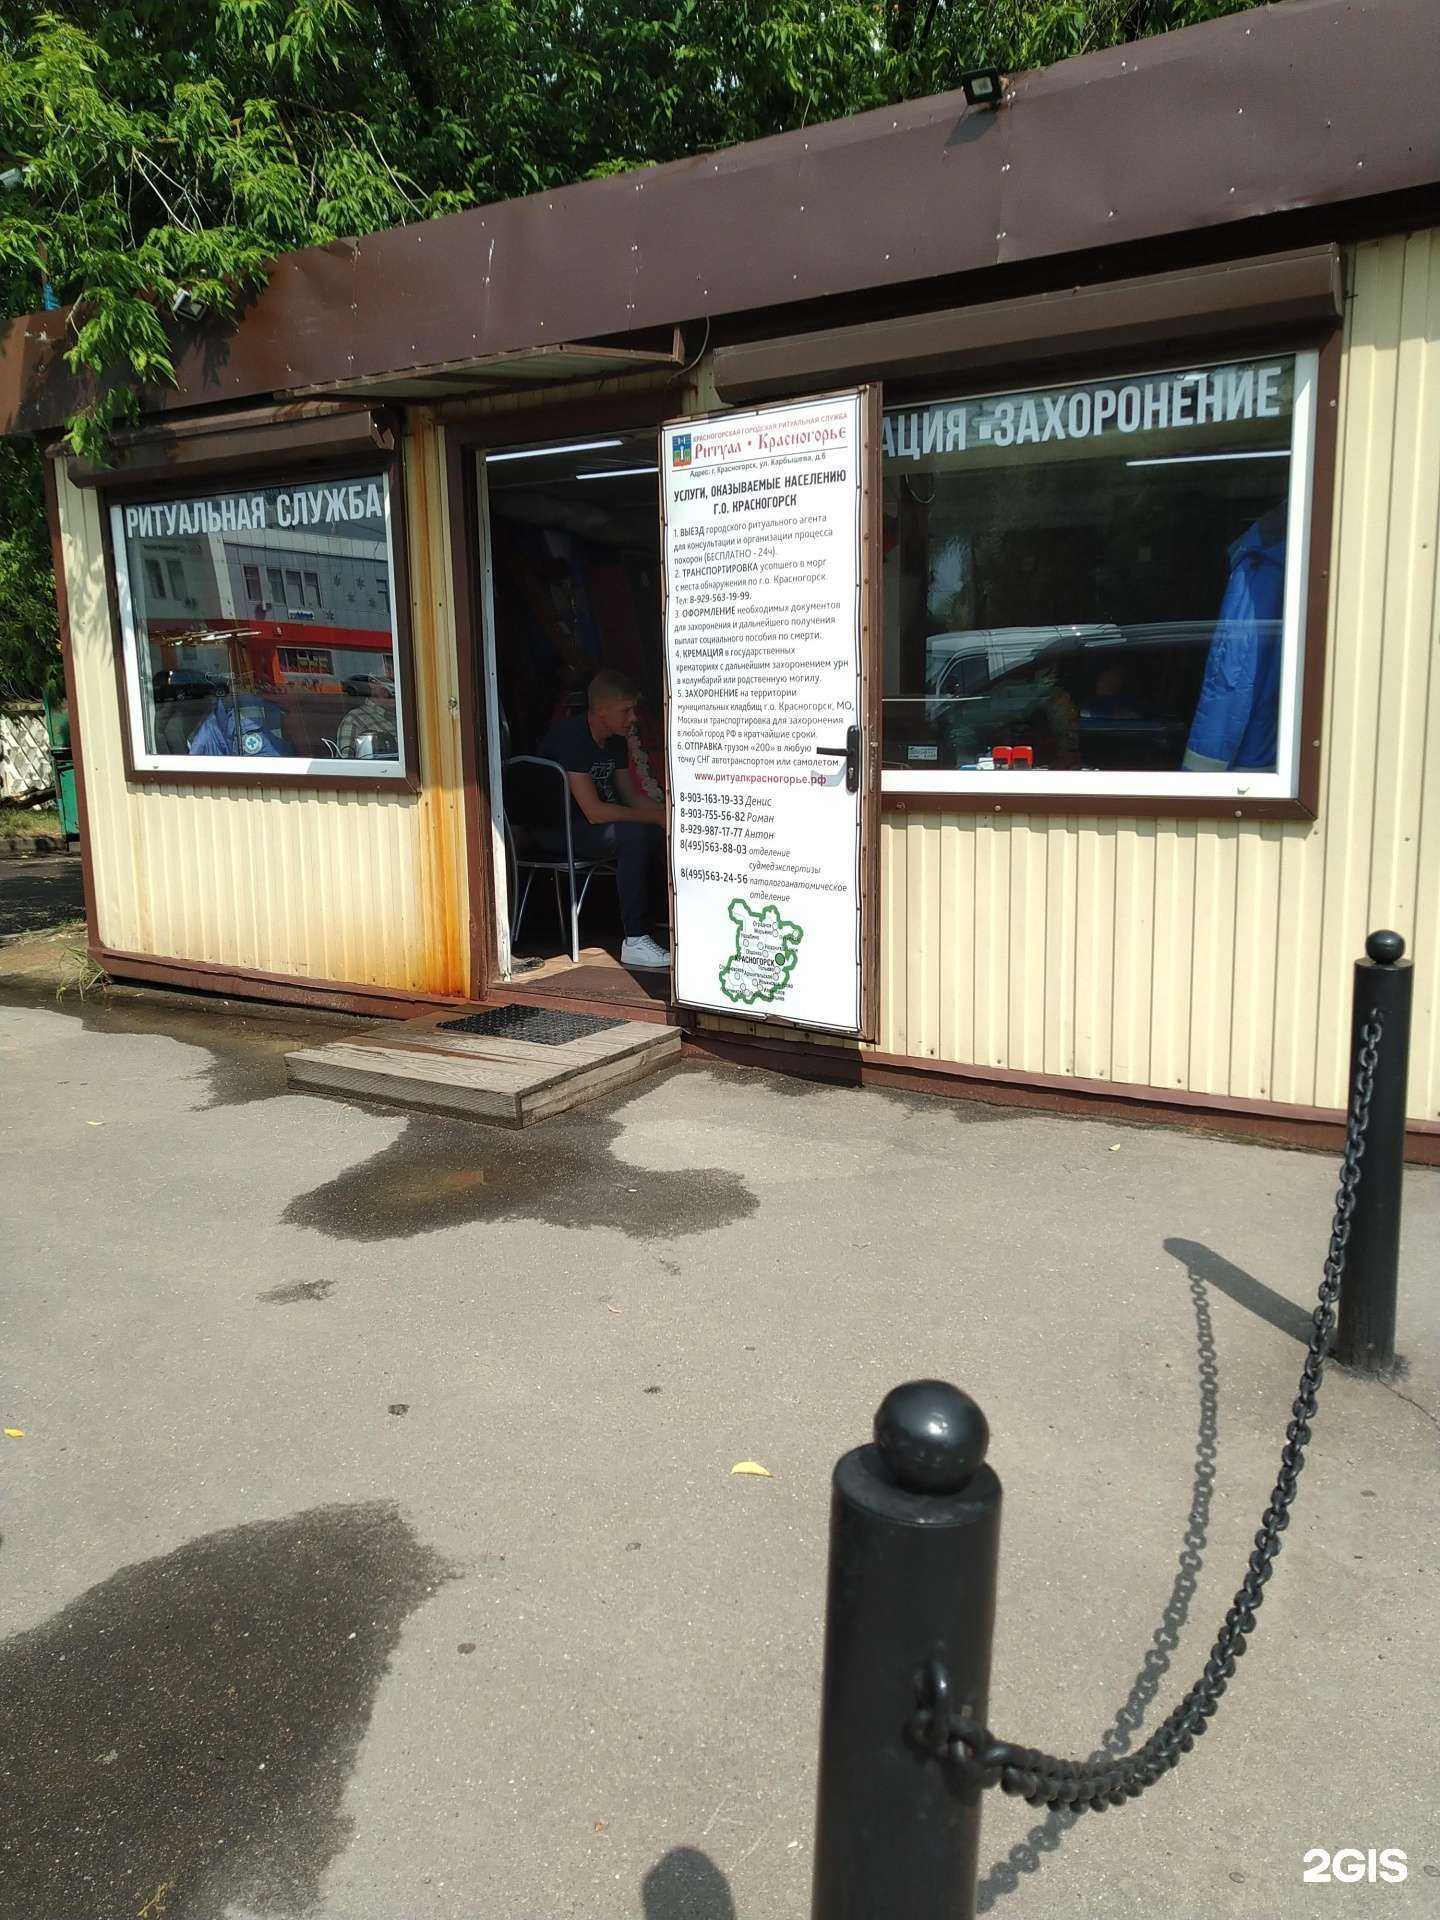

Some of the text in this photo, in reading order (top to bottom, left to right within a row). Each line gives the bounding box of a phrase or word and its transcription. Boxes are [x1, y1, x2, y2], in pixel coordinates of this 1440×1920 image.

[994, 367, 1282, 447] ЗАХОРОНЕНИЕ
[693, 412, 848, 442] КРАСНОГОРСКАЯ ГОРОДСКАЯ РИТУАЛЬНАЯ СЛУЖБА
[695, 427, 846, 460] Ритуал Красногорье
[674, 469, 847, 502] УСЛУГИ, ОКАЗЫВАЕМЫЕ НАСЕЛЕНИЮ
[126, 484, 382, 538] РИТУАЛЬНАЯ СЛУЖБА
[713, 494, 797, 515] Г.О. КРАСНОГОРСК
[680, 526, 704, 537] ВЫЕЗД
[706, 522, 746, 535] городского
[748, 518, 798, 532] ритуального
[799, 515, 827, 524] агента
[674, 543, 685, 553] для
[687, 538, 735, 551] консультации
[743, 533, 793, 545] организации
[795, 529, 833, 541] процесса
[674, 556, 703, 565] похорон
[704, 549, 752, 563] (БЕСПЛАТНО
[683, 562, 758, 578] ТРАНСПОРТИРОВКА
[760, 561, 798, 573] усопшего
[799, 560, 805, 568] в
[807, 559, 827, 568] морг
[680, 583, 699, 591] места
[700, 579, 746, 591] обнаружения
[682, 606, 735, 618] ОФОРМЛЕНИЕ
[737, 604, 789, 615] необходимых
[791, 602, 840, 613] документов
[674, 624, 686, 633] для
[688, 622, 731, 632] захоронения
[739, 618, 789, 629] дальнейшего
[791, 617, 836, 628] получения
[674, 637, 698, 645] выплат
[699, 635, 743, 645] социального
[745, 632, 776, 642] пособия
[683, 648, 723, 658] КРЕМАЦИЯ
[724, 649, 730, 657] в
[730, 647, 796, 659] государственных
[676, 663, 719, 674] крематориях
[725, 660, 770, 671] дальнейшим
[772, 660, 831, 671] захоронением
[832, 659, 849, 670] урн
[681, 675, 722, 686] колумбарий
[723, 676, 736, 684] или
[737, 676, 788, 686] родственную
[684, 688, 739, 698] ЗАХОРОНЕНИЕ
[750, 689, 797, 700] территории
[677, 703, 729, 713] муниципальных
[730, 701, 763, 712] кладбищ
[763, 703, 777, 711] г.о.
[836, 700, 855, 711] МО,
[677, 716, 703, 724] Москвы
[709, 717, 771, 727] транспортировка
[772, 717, 787, 725] для
[788, 717, 844, 726] захоронения
[682, 729, 703, 737] любой
[704, 730, 724, 739] город
[726, 729, 737, 737] РФ
[743, 729, 790, 740] кратчайшие
[684, 741, 722, 751] ОТПРАВКА
[724, 744, 749, 754] грузом
[750, 743, 776, 752] «200»
[783, 743, 812, 755] любую
[678, 756, 695, 766] точку
[696, 755, 711, 764] СНГ
[711, 757, 775, 767] автотранспортом
[694, 773, 827, 787] www.ритуалкрасногорье.рф
[679, 792, 772, 807] 8-903-163-19-33 Денис
[680, 808, 775, 824] 8-903-755-56-82 Роман
[680, 823, 775, 840] 8-929-987-17-77 Антон
[680, 839, 791, 858] 8(495)563-88-03 отделение
[748, 860, 821, 875] судмедэкспертизы
[680, 868, 848, 892] 8(495)563-24-56 патологоанатомическое
[749, 890, 791, 902] отделение
[735, 954, 775, 967] КРАСНОГОРСК
